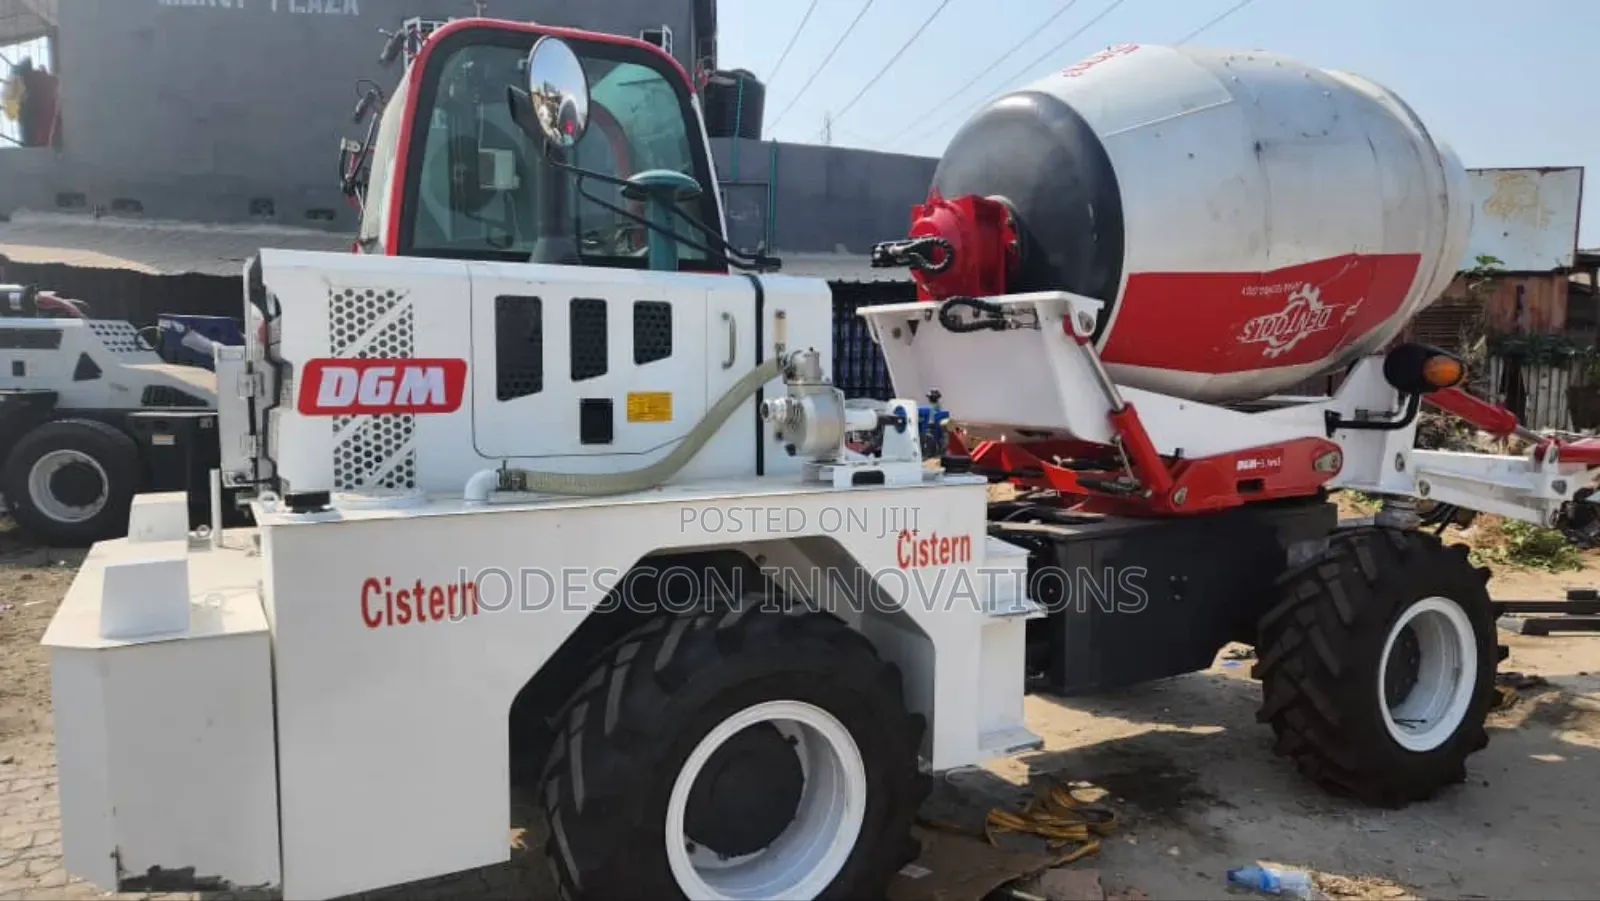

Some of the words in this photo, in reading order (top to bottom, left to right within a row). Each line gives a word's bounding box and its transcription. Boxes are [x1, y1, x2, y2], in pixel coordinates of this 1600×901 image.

[1243, 307, 1332, 341] DENTOOLS
[317, 366, 447, 407] DGM
[897, 529, 971, 570] Cistern
[361, 576, 478, 628] Cistern
